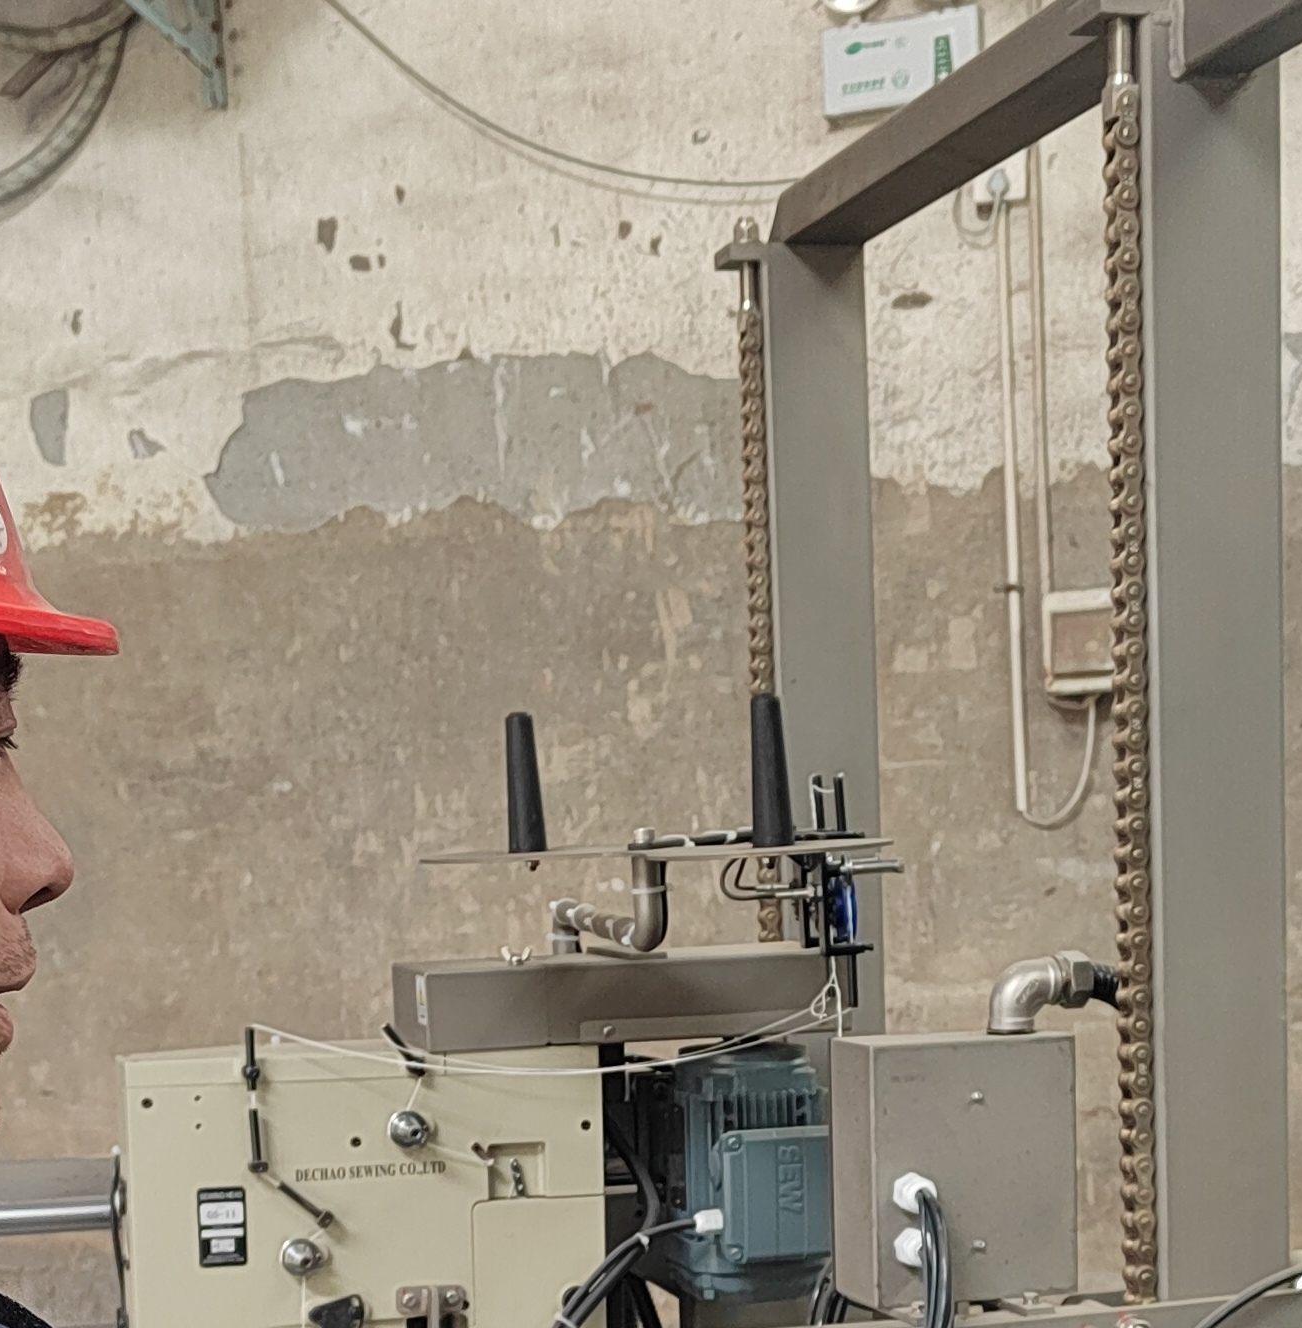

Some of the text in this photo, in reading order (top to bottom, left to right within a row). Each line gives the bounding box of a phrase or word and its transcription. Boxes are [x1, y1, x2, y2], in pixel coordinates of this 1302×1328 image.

[295, 1167, 346, 1182] DECHAO
[349, 1163, 396, 1179] SEWING
[778, 1145, 804, 1215] SEW
